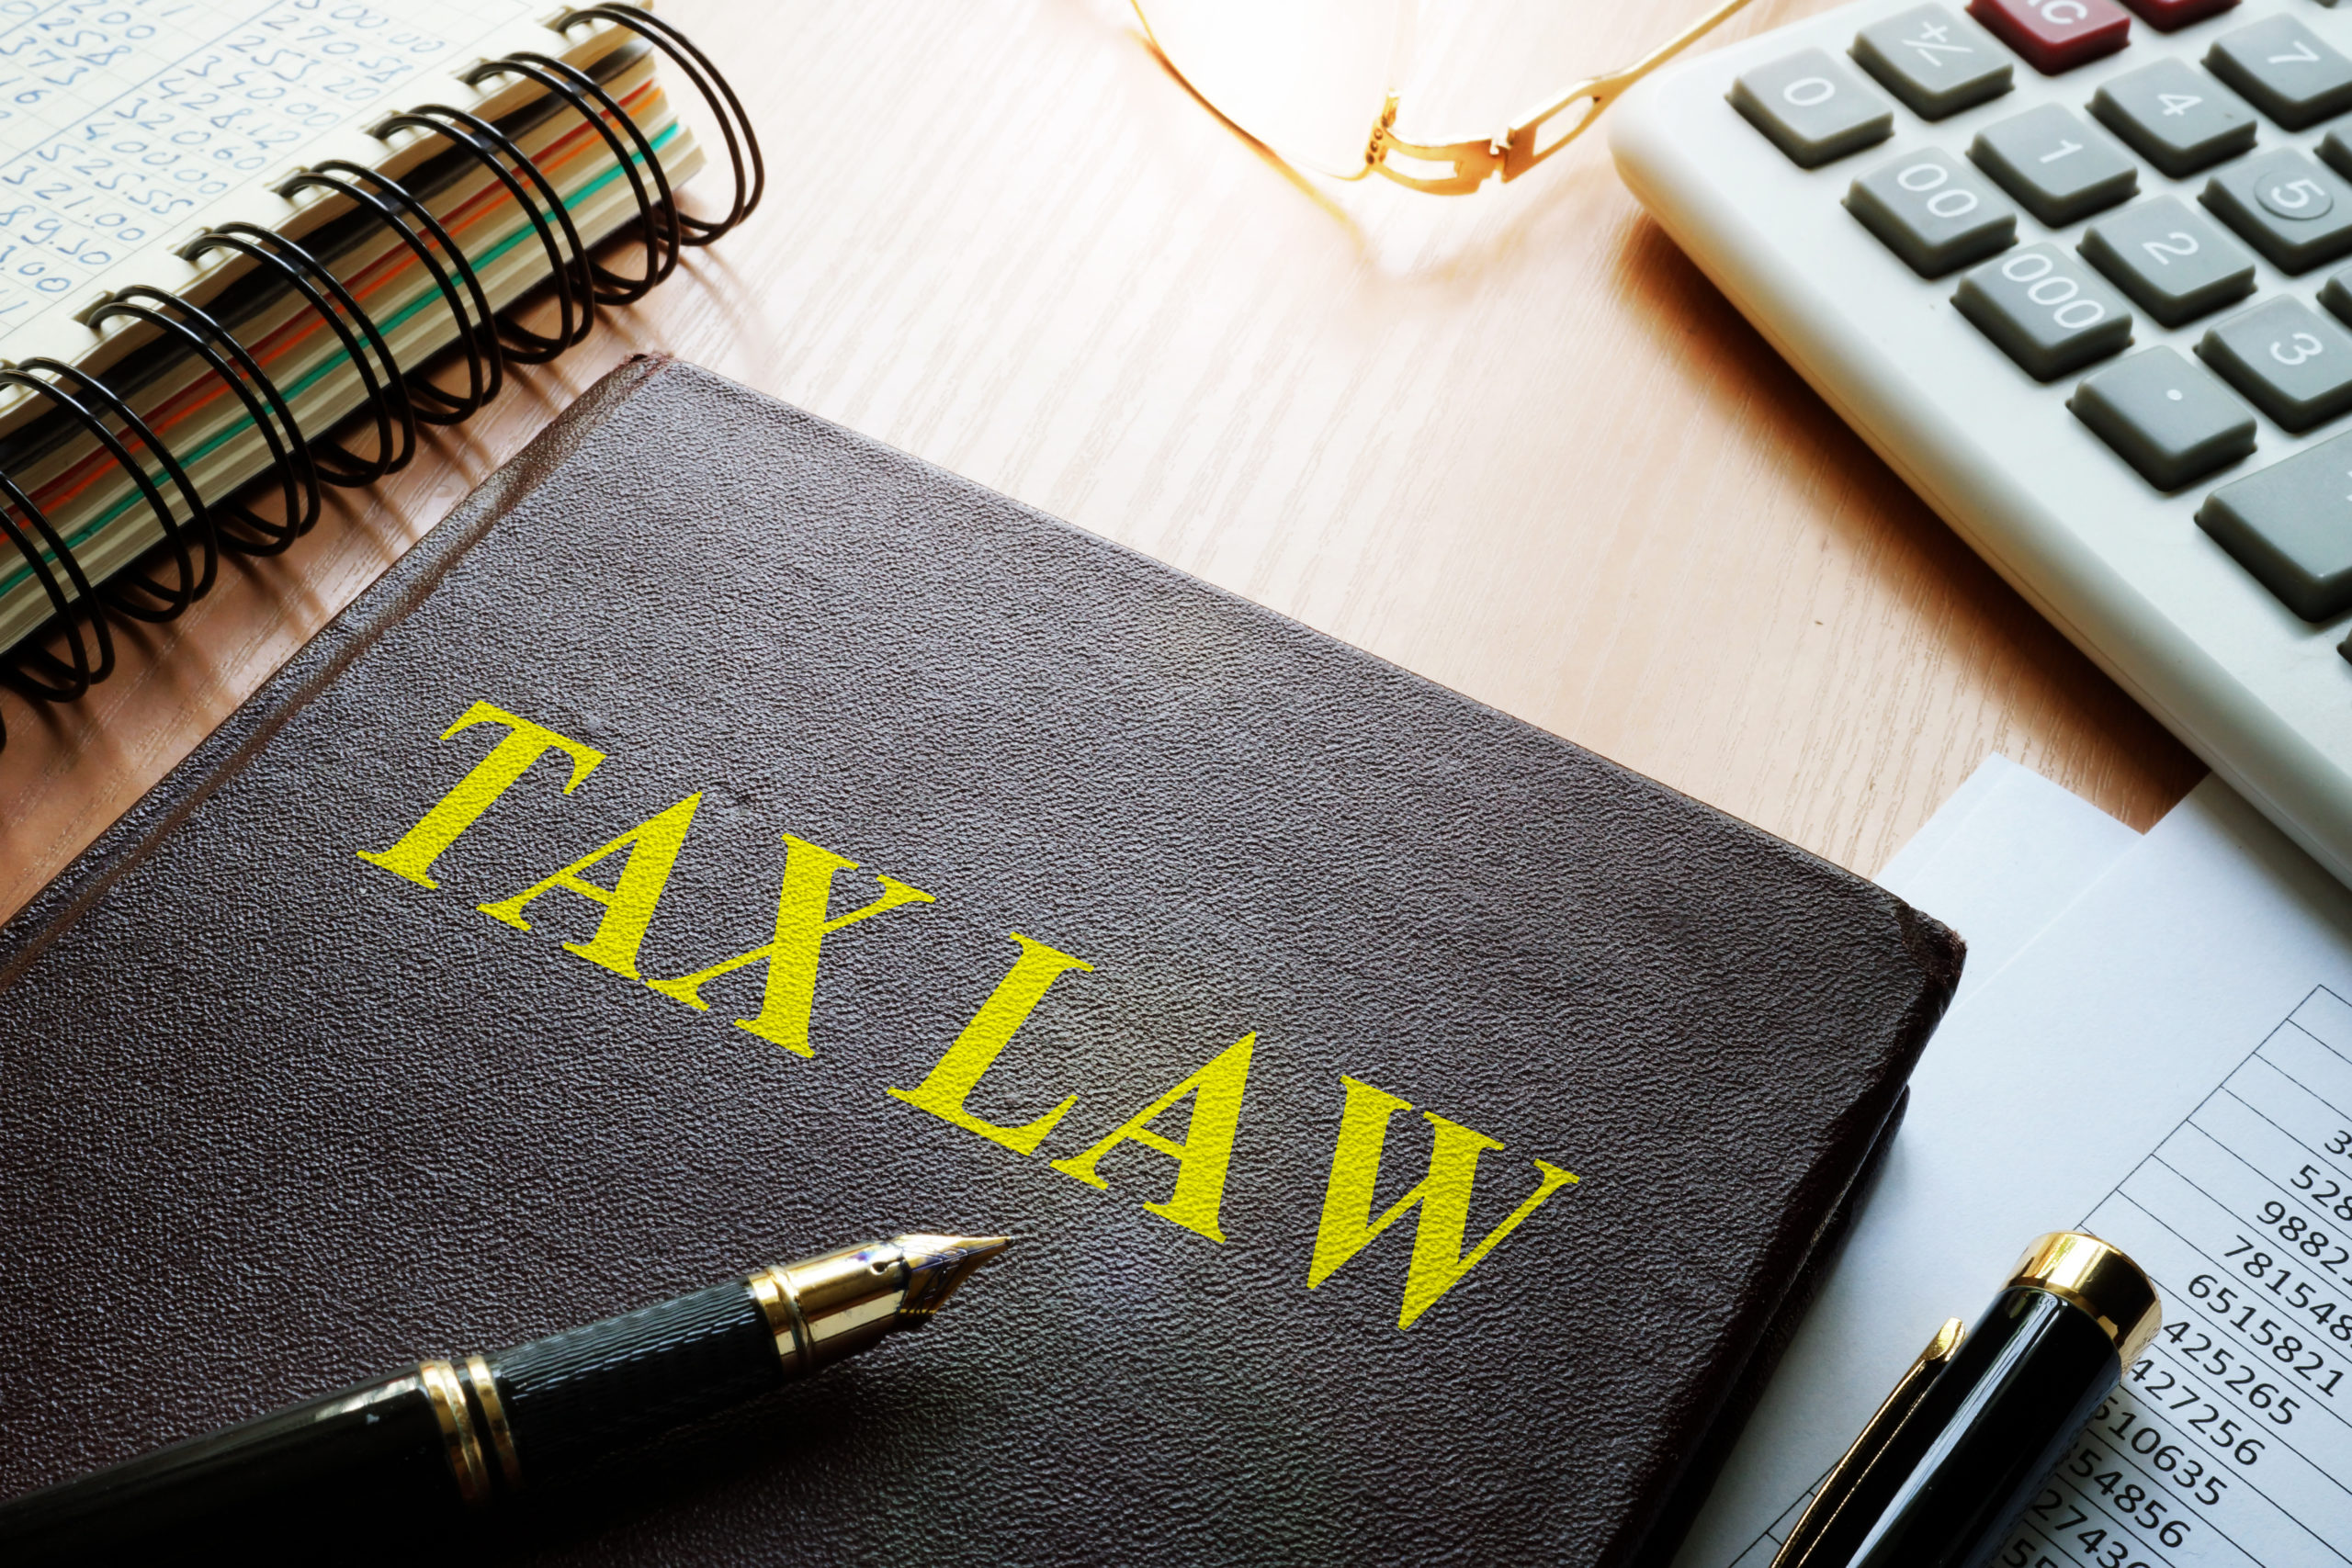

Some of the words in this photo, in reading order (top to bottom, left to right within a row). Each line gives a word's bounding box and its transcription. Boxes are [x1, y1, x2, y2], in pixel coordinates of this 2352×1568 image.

[2027, 0, 2088, 25] C
[2267, 40, 2321, 64] 7
[1783, 77, 1836, 107] 0
[2157, 93, 2204, 117] 4
[2039, 139, 2084, 164] 1
[1897, 163, 1979, 220] 00
[2271, 178, 2326, 209] 5
[2143, 231, 2199, 266] 2
[2001, 253, 2107, 331] 000
[2269, 332, 2324, 367] 3
[356, 700, 936, 1058] TAX
[888, 931, 1580, 1331] LAW
[2324, 1130, 2352, 1160] 3
[2256, 1201, 2352, 1287] 9882
[2223, 1235, 2352, 1348] 781548
[2188, 1274, 2345, 1397] 6515821
[2163, 1320, 2301, 1426] 425265
[2131, 1357, 2266, 1465] 427256
[2069, 1441, 2192, 1549] 54856
